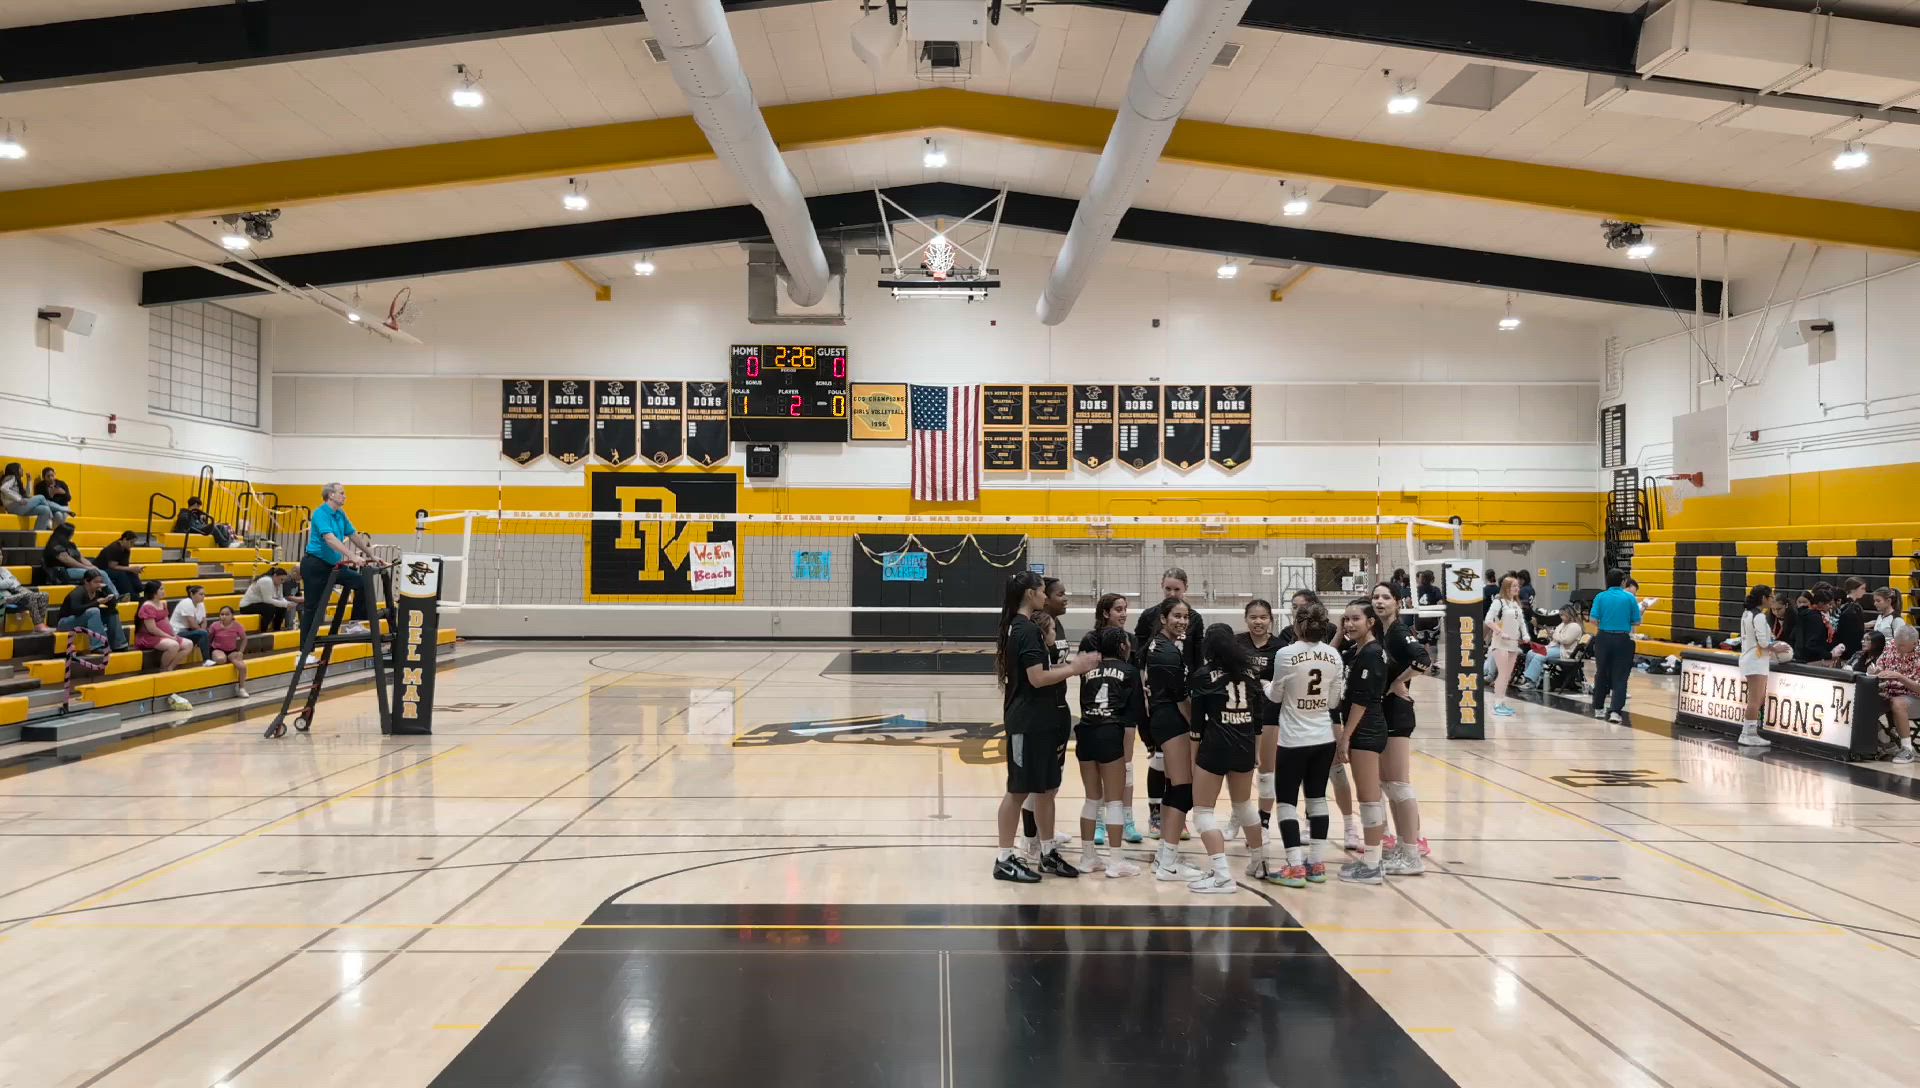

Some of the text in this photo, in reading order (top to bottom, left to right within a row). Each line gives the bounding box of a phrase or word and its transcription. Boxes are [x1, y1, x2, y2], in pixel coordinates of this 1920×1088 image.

[733, 347, 759, 356] HOME
[775, 346, 814, 367] 2:26
[817, 348, 846, 357] GUEST
[746, 356, 759, 377] 0
[833, 357, 845, 377] 0
[509, 395, 537, 404] DONS
[555, 395, 584, 405] DONS
[601, 396, 630, 405] DONS
[647, 396, 676, 406] DONS
[693, 397, 722, 406] DONS
[790, 395, 802, 416] 2
[832, 395, 845, 417] 0
[1080, 400, 1108, 410] DONS
[1125, 400, 1153, 410] DONS
[1171, 400, 1199, 410] DONS
[1216, 400, 1245, 410] DONS
[693, 544, 713, 561] We
[694, 566, 732, 582] Beach
[402, 610, 424, 719] DEL MAR
[1291, 651, 1336, 665] DEL MAR
[1103, 667, 1124, 681] MAR
[1457, 616, 1478, 724] DEL MAR
[1307, 669, 1322, 695] 2
[1682, 671, 1707, 696] DEL
[1712, 675, 1749, 704] MAR
[1094, 683, 1109, 709] 4
[1225, 681, 1248, 709] 11
[1297, 698, 1327, 710] DONS
[1680, 696, 1704, 714] HIGH
[1221, 711, 1252, 724] DONS
[1766, 696, 1824, 736] DONS
